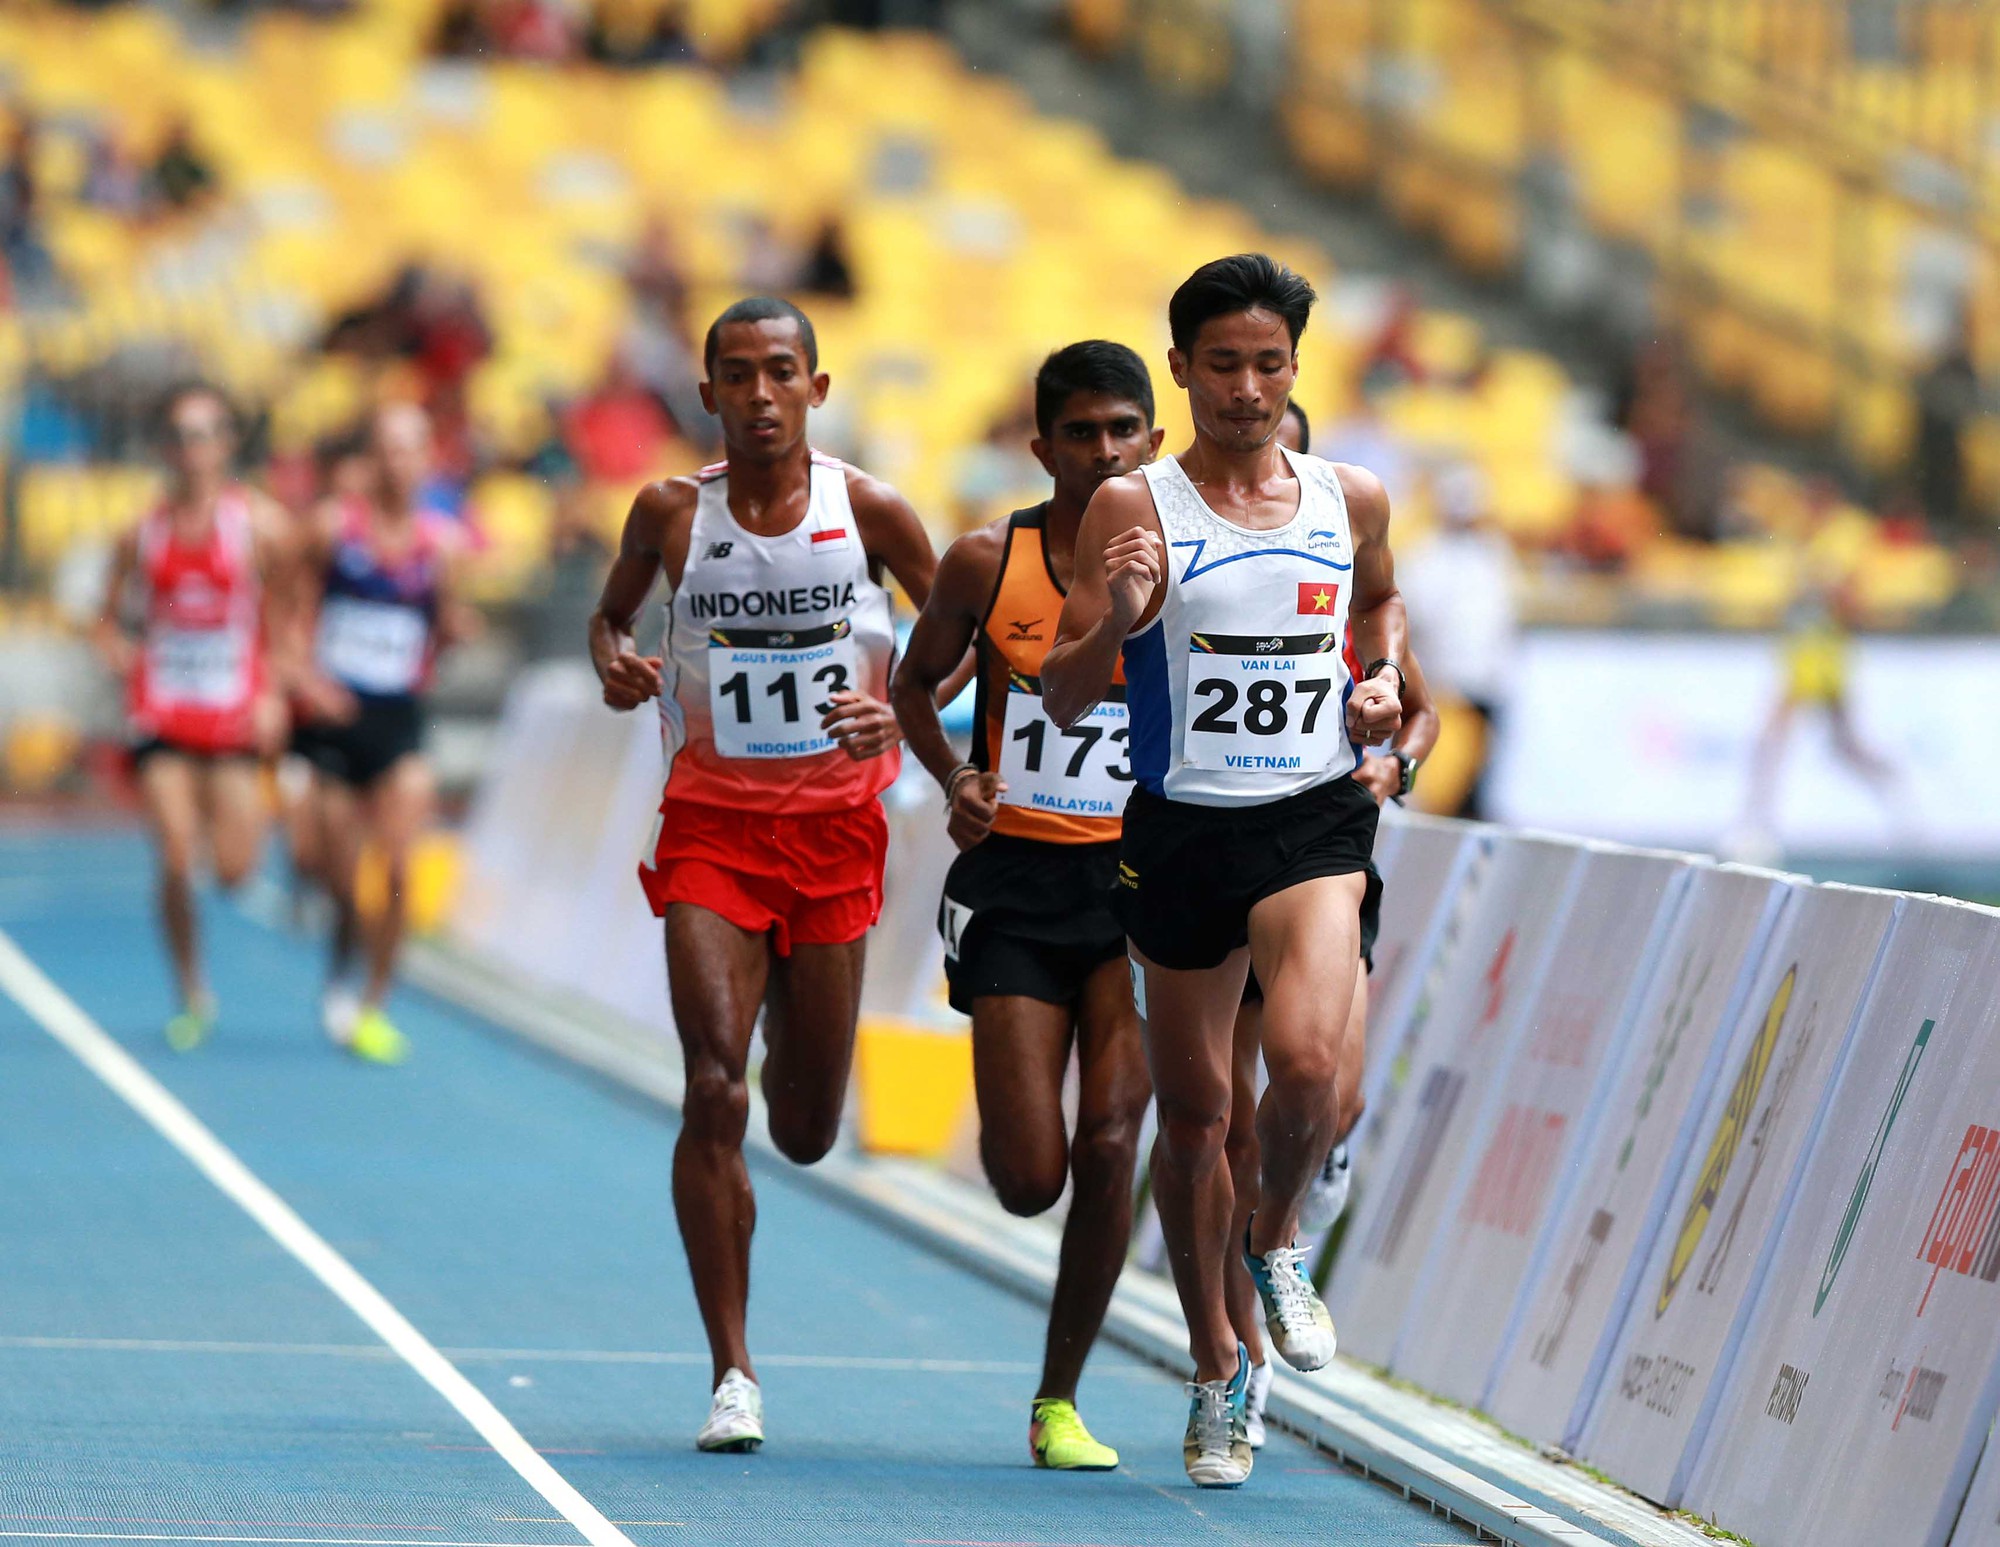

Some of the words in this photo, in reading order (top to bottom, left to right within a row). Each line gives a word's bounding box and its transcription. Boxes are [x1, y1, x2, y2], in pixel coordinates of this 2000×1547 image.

[690, 582, 857, 619] INDONESIA
[732, 652, 768, 664] AGUS
[771, 647, 834, 664] PRAYOGO
[1241, 660, 1270, 671] VAN
[1275, 660, 1296, 671] LAI
[719, 663, 852, 723] 113
[1191, 678, 1332, 736] 287
[746, 737, 834, 754] INDONESIA
[1012, 719, 1137, 782] 173
[1225, 755, 1301, 769] VIETNAM
[1031, 793, 1114, 813] MALAYSIA
